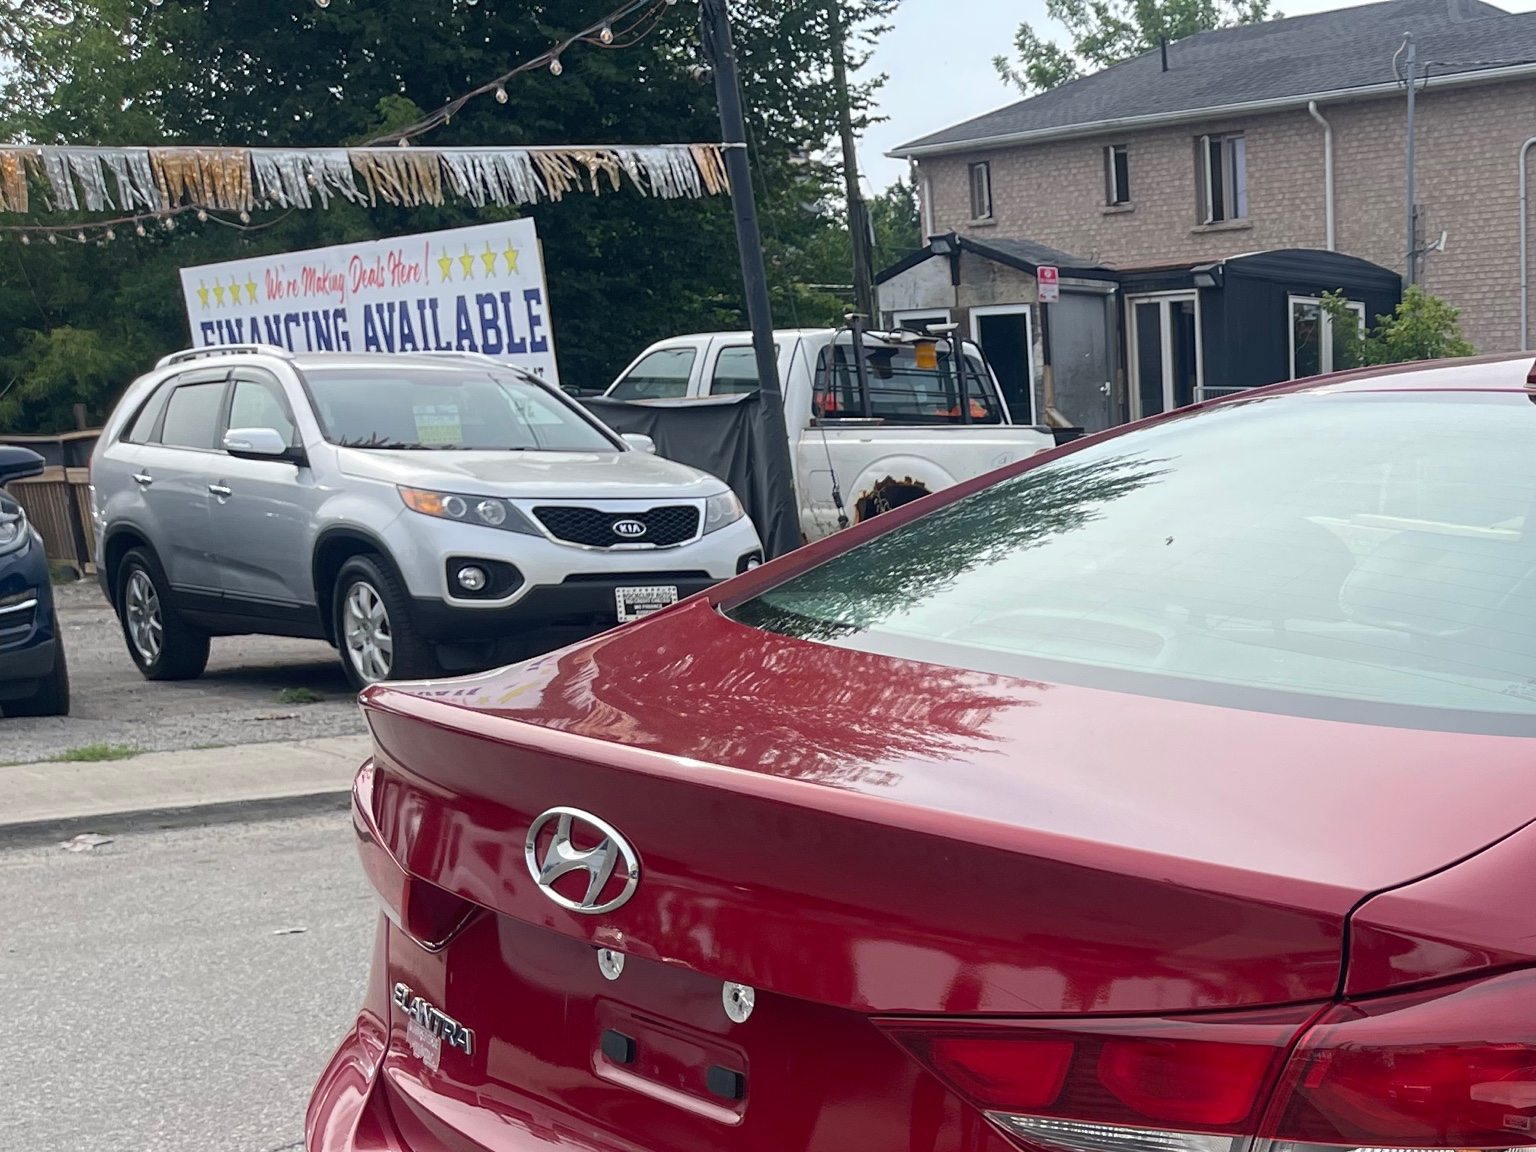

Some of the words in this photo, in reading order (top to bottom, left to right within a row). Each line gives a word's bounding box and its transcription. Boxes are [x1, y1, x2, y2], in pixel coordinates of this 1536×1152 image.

[265, 264, 299, 300] We're
[301, 262, 345, 304] Making
[349, 254, 384, 294] Deals
[387, 240, 430, 287] Here!
[200, 307, 351, 353] FINANCING
[364, 288, 548, 354] AVAILABLE
[619, 523, 641, 533] KIA
[394, 982, 473, 1055] ELANTRA
